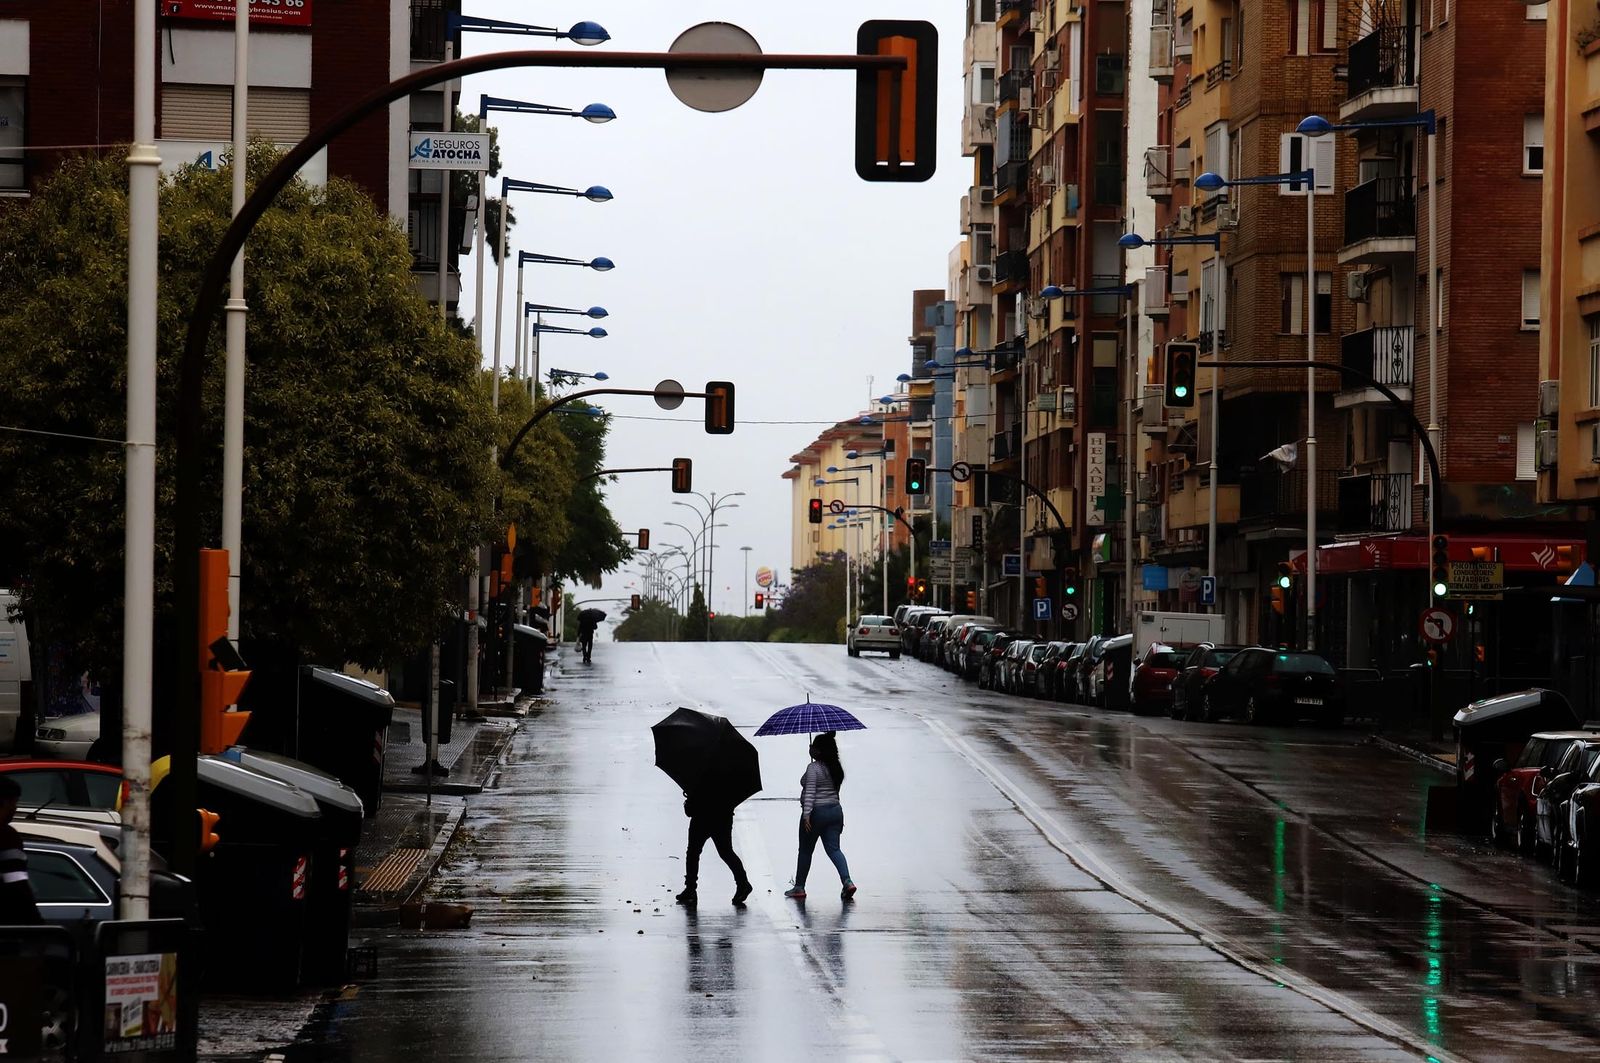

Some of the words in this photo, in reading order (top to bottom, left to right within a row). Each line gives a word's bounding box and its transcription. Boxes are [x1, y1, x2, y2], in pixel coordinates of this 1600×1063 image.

[433, 140, 480, 150] SEGUROS
[432, 150, 481, 160] ATOCHA
[1203, 580, 1212, 601] P
[1037, 602, 1047, 617] P
